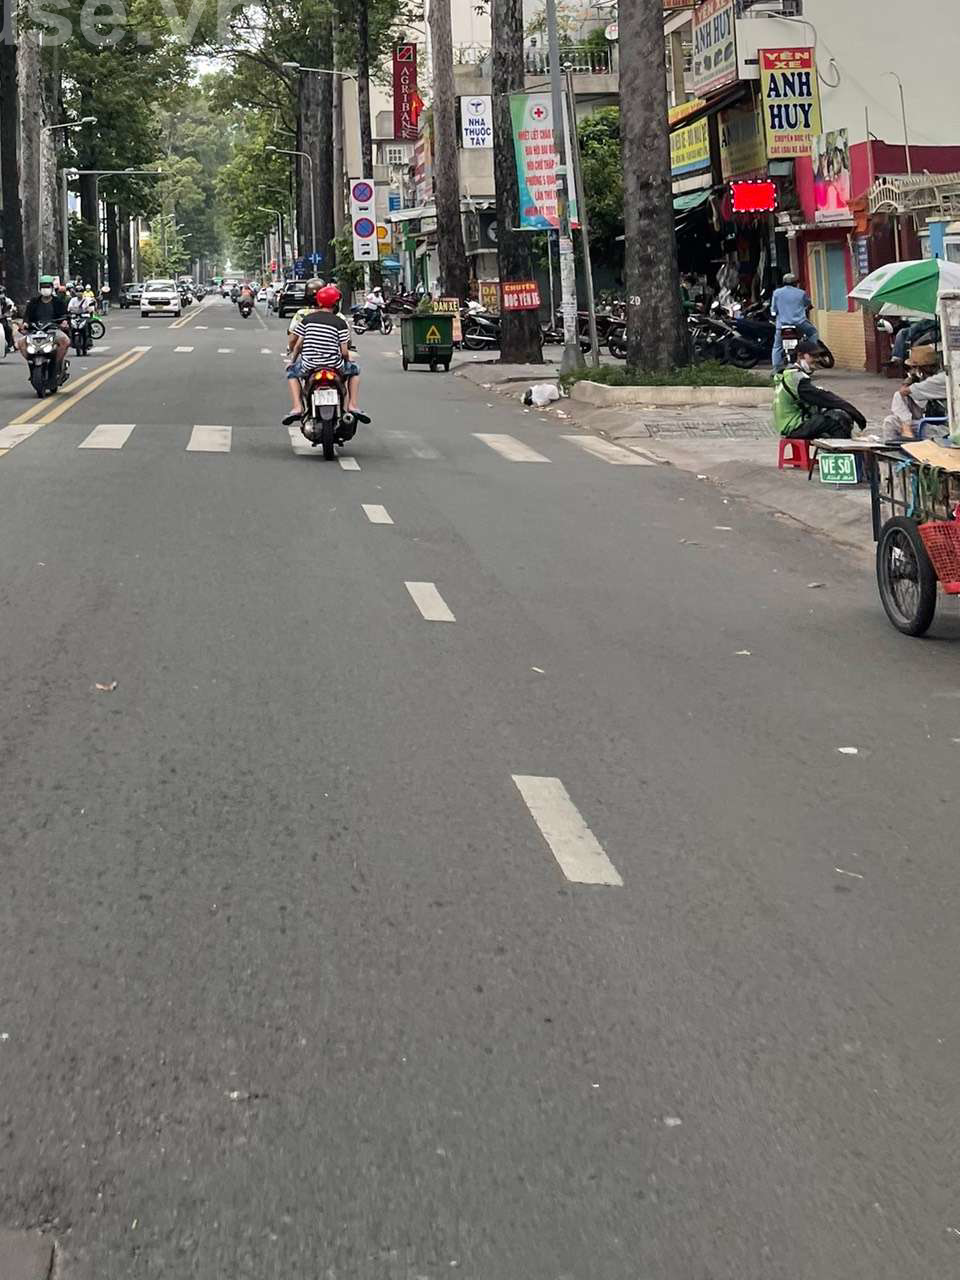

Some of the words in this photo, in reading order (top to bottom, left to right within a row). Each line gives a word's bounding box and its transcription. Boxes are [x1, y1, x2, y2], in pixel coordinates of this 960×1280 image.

[693, 22, 712, 56] ANH
[713, 6, 732, 45] HUY
[765, 51, 810, 61] YÊN
[774, 60, 802, 69] XE
[767, 71, 813, 99] ANH
[400, 66, 411, 139] AGRIBANK
[768, 102, 813, 130] HUY
[629, 295, 641, 306] 20
